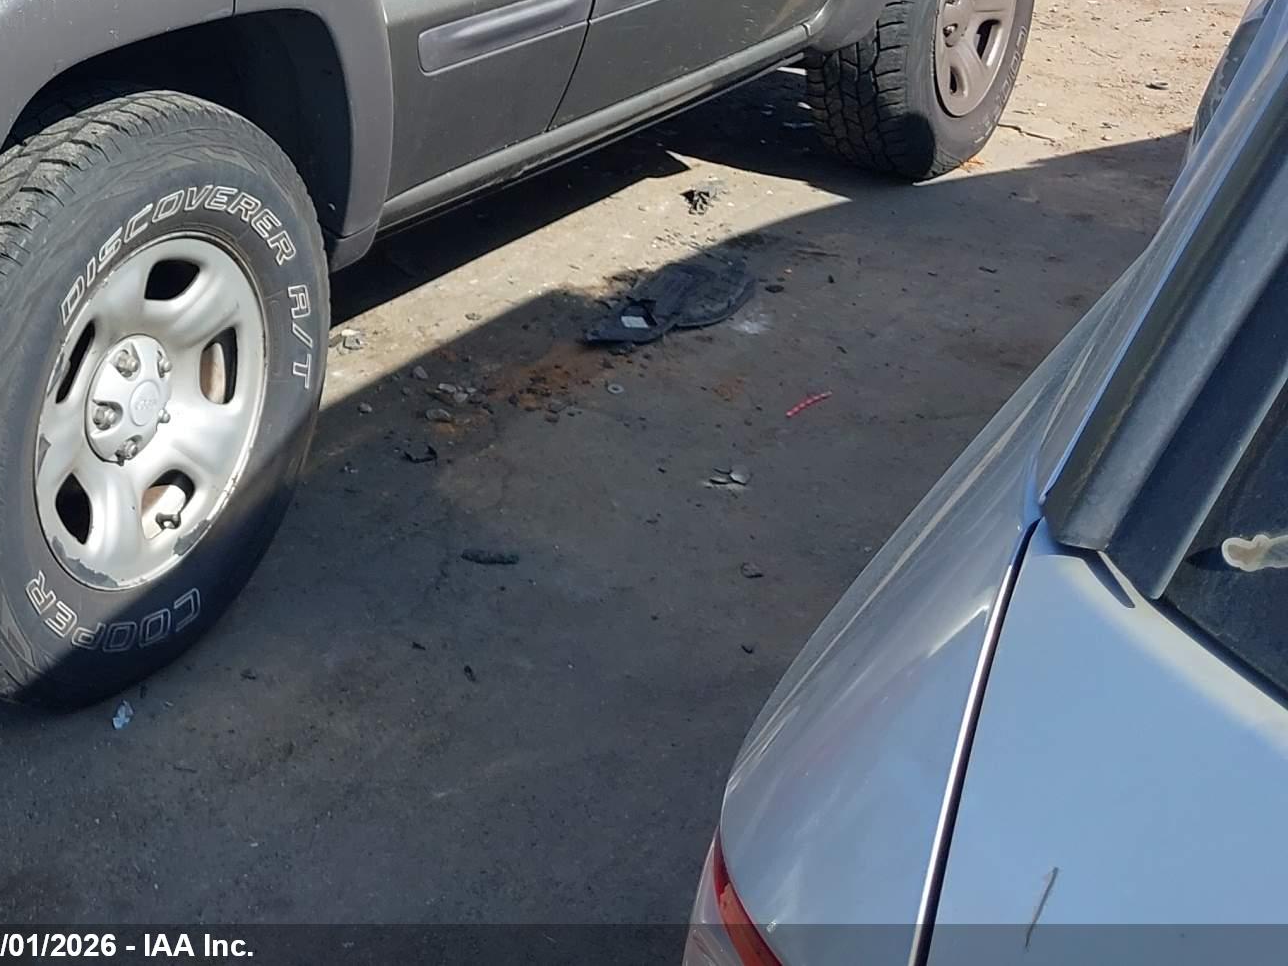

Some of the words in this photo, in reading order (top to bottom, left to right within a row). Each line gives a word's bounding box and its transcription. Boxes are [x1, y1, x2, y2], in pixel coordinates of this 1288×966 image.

[59, 183, 299, 327] DISCOVERER
[286, 283, 314, 390] A/T
[24, 568, 202, 655] COOPER
